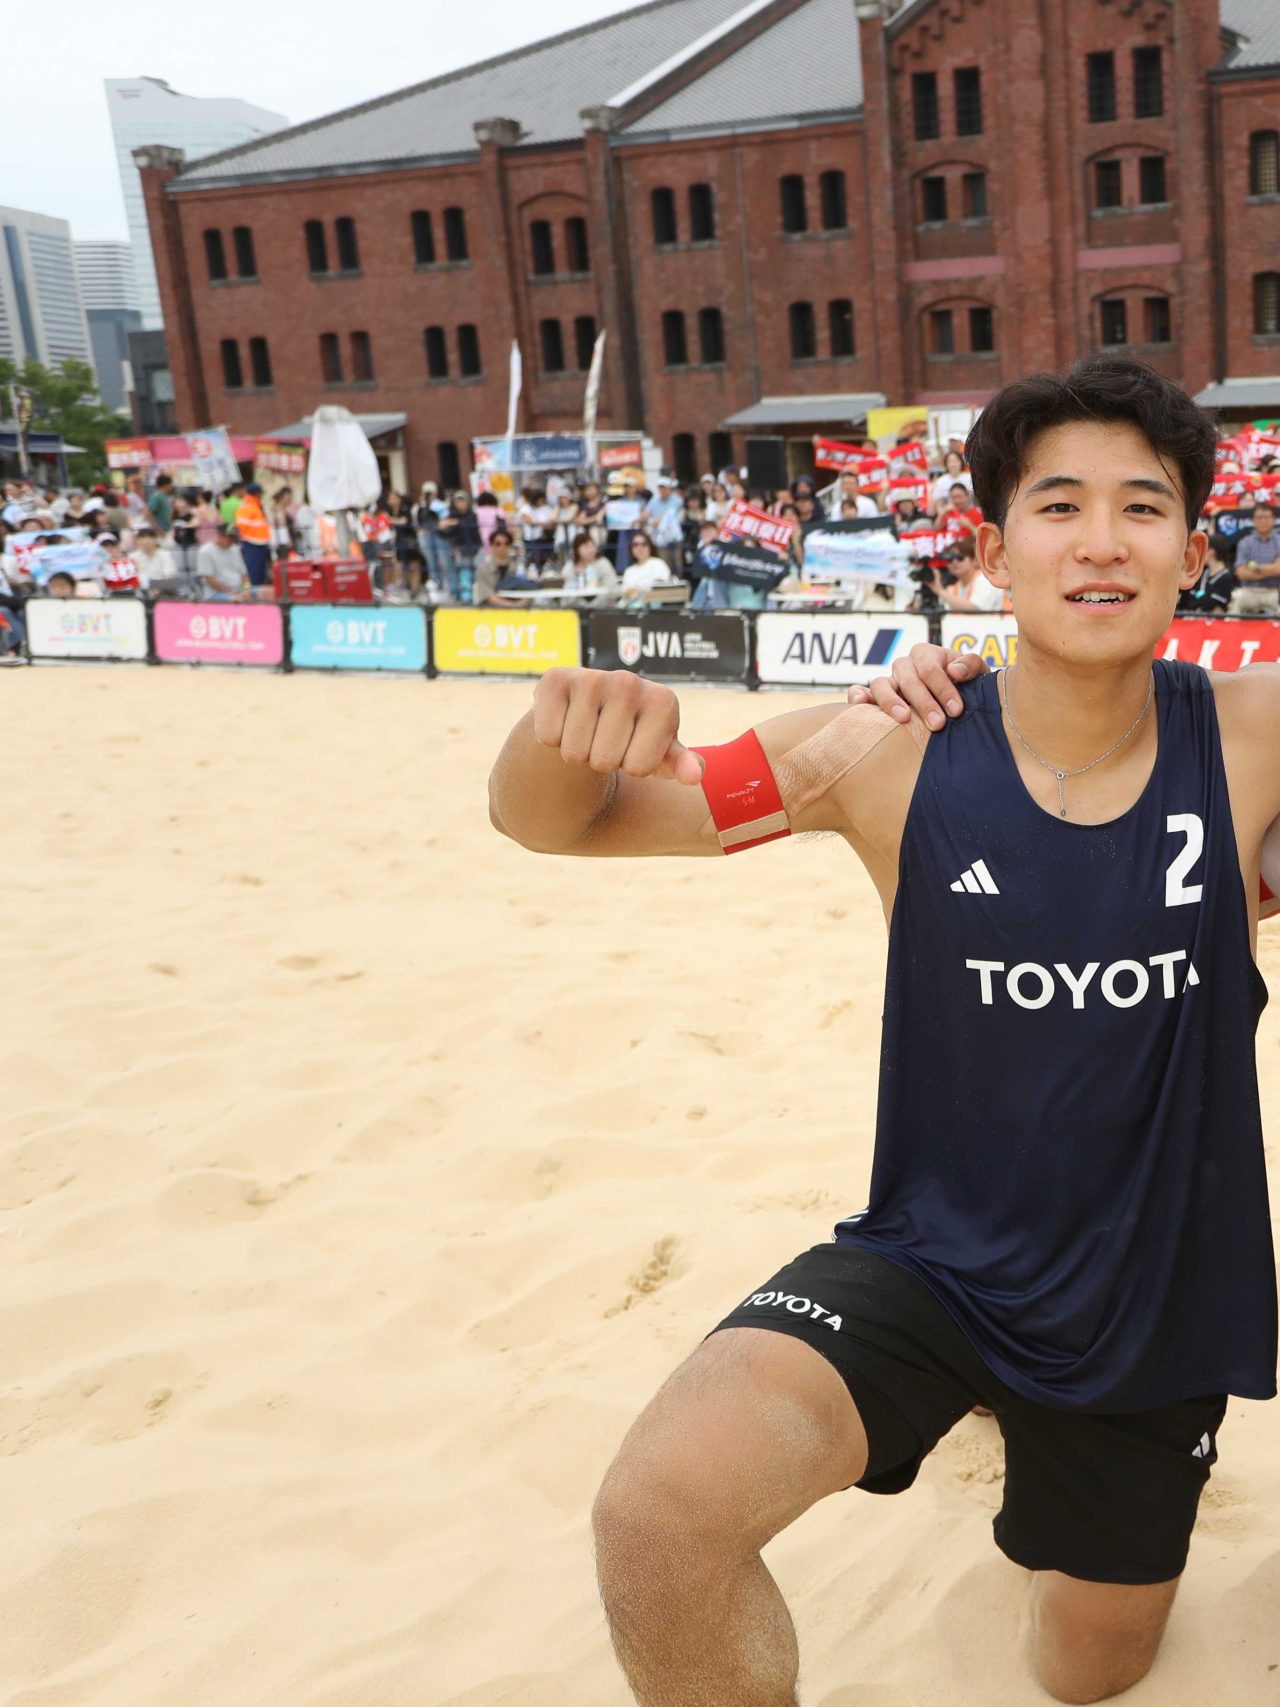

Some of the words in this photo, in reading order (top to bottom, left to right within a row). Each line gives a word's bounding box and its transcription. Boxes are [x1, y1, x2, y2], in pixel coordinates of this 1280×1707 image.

[209, 616, 247, 640] BVT
[347, 621, 388, 646] BVT
[495, 624, 539, 649] BVT
[642, 631, 682, 658] JVA
[781, 631, 859, 665] ANA
[1165, 813, 1204, 908] 2
[743, 1291, 843, 1332] TOYOTA
